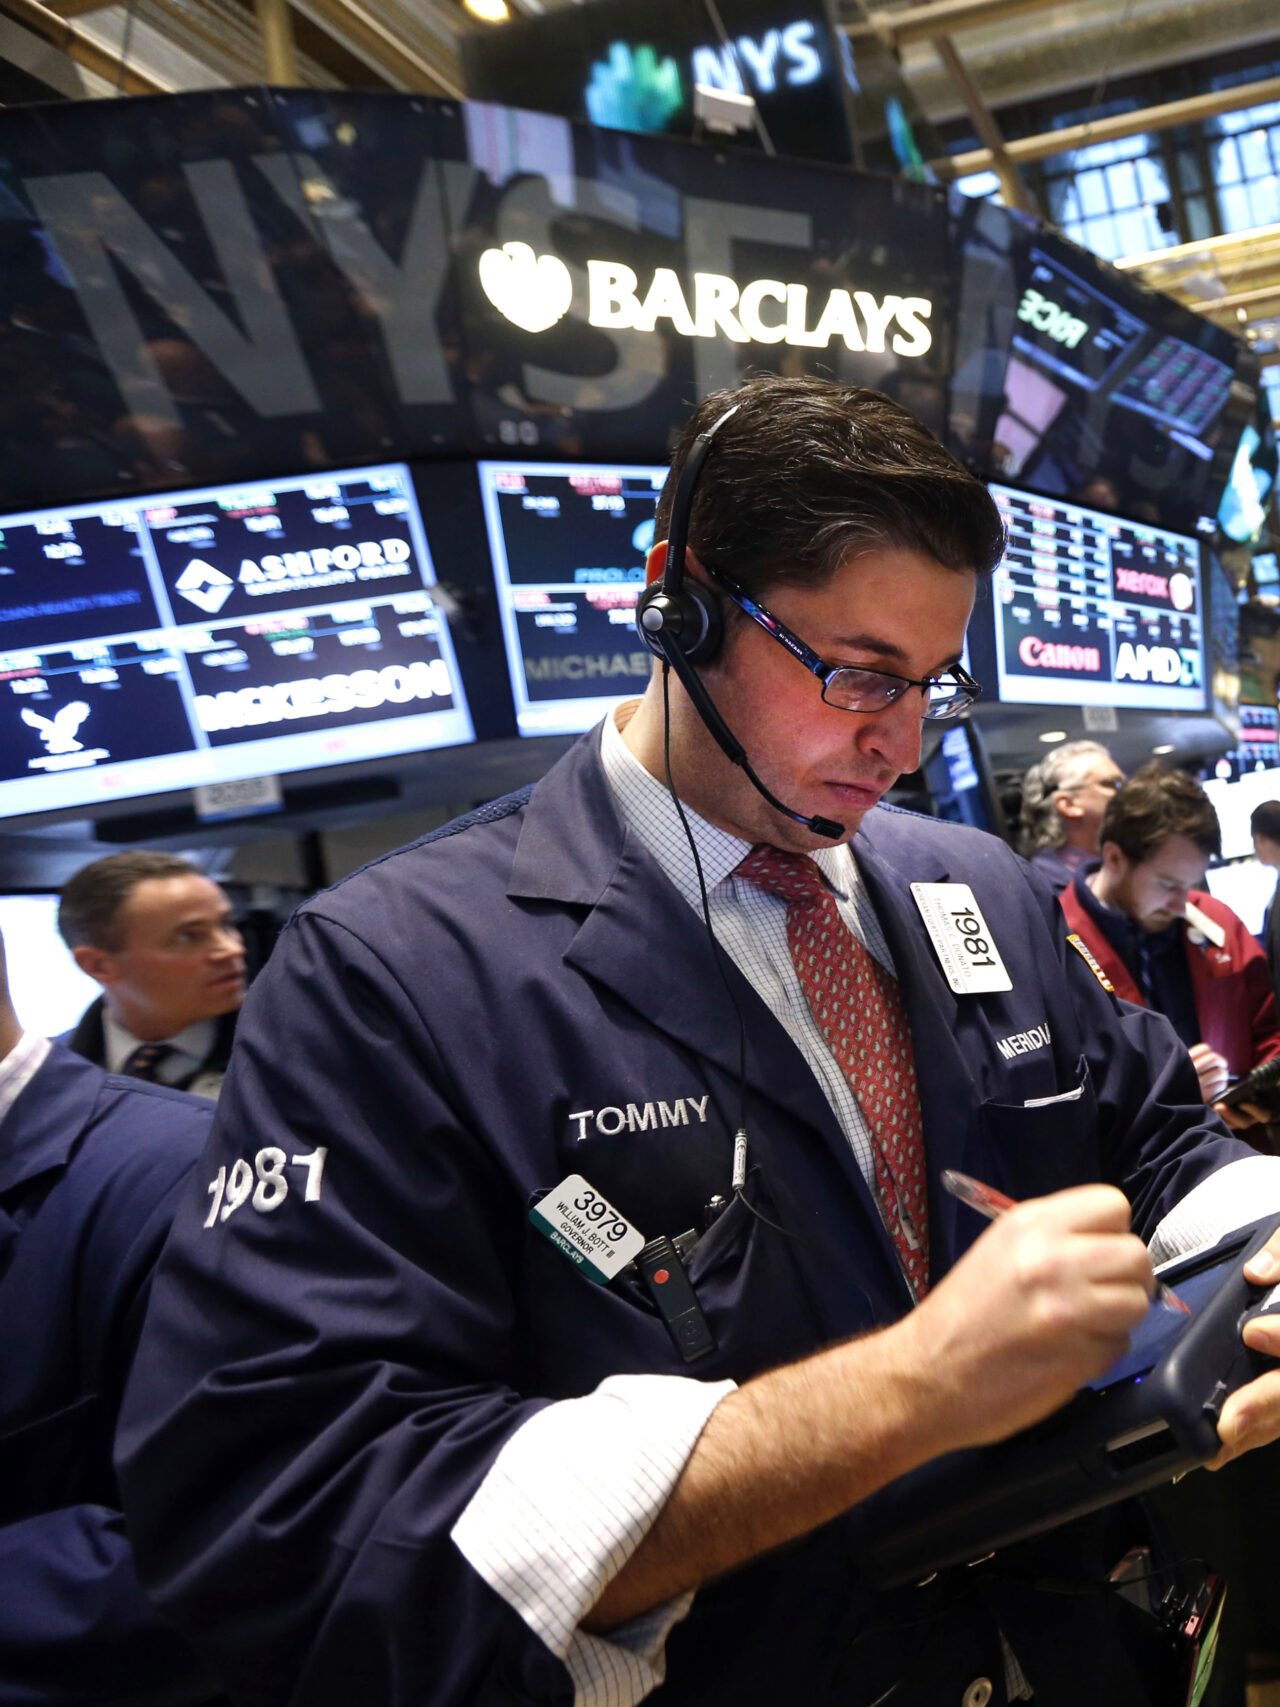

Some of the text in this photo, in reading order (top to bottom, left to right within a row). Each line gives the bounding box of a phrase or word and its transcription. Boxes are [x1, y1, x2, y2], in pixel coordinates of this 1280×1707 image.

[587, 259, 933, 357] BARCLAYS
[238, 538, 411, 585] ASHFORD
[1018, 635, 1101, 672] Canon
[1114, 642, 1181, 684] AMD
[951, 907, 996, 967] 1981
[569, 1095, 710, 1141] TOMMY
[556, 1201, 586, 1231] WILLIAM
[581, 1226, 592, 1237] J.
[588, 1232, 611, 1253] BOTT
[559, 1221, 595, 1255] GOVERNOR
[574, 1189, 629, 1243] 3979
[550, 1231, 585, 1264] BARCLAYS
